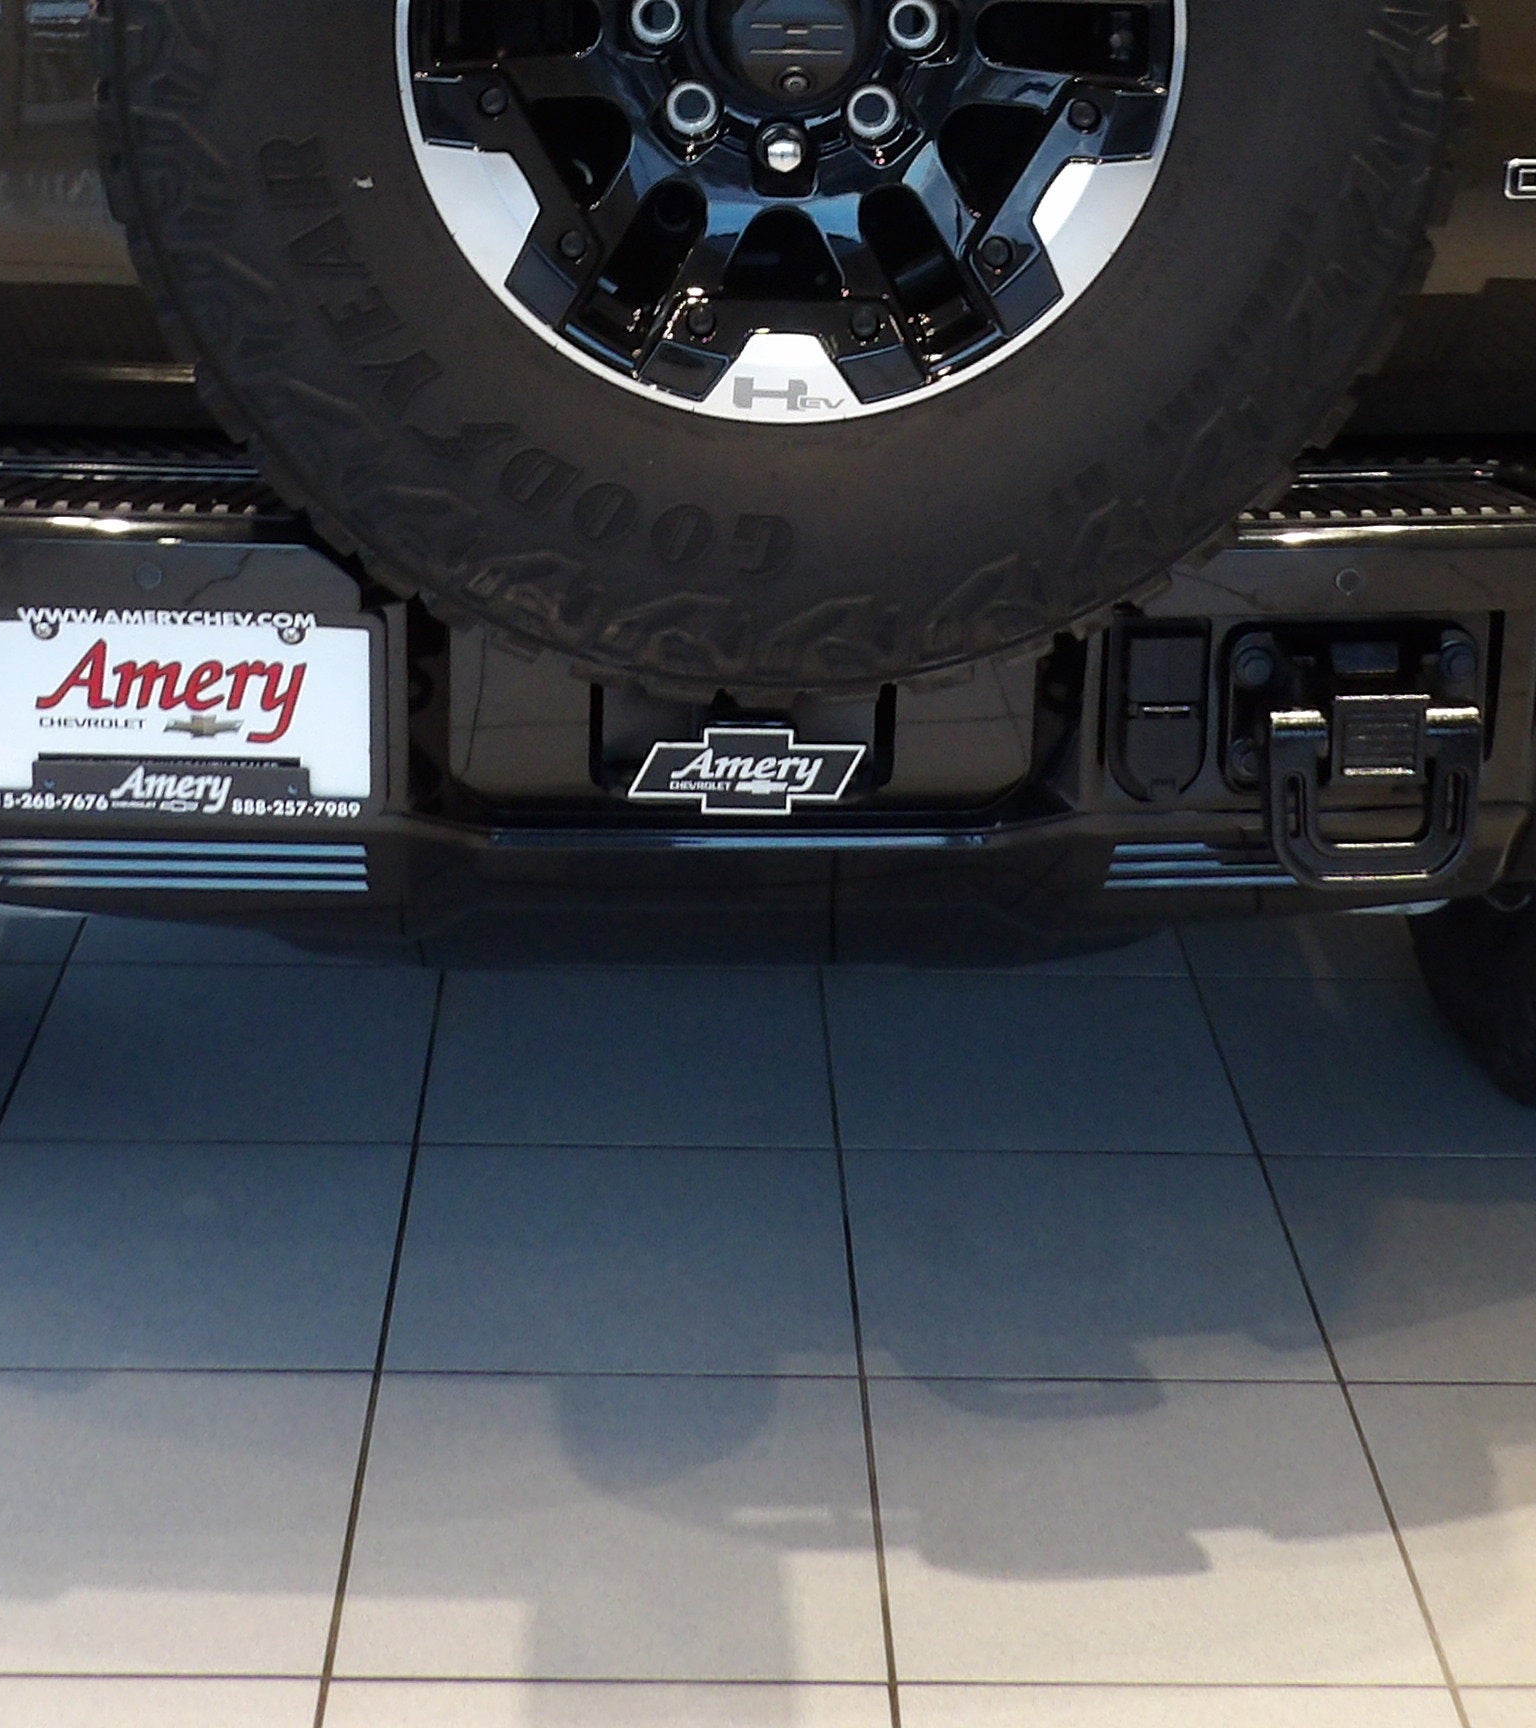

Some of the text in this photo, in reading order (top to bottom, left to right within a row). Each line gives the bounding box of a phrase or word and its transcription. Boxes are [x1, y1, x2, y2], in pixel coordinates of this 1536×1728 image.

[256, 134, 796, 578] GOODYEAR
[17, 606, 316, 630] WWW.AMERYCHEV.COM
[35, 638, 308, 743] Amery
[39, 716, 147, 730] CHEVROLET
[109, 765, 233, 814] Amery
[669, 781, 731, 792] CHEVROLET
[670, 747, 824, 793] Amery
